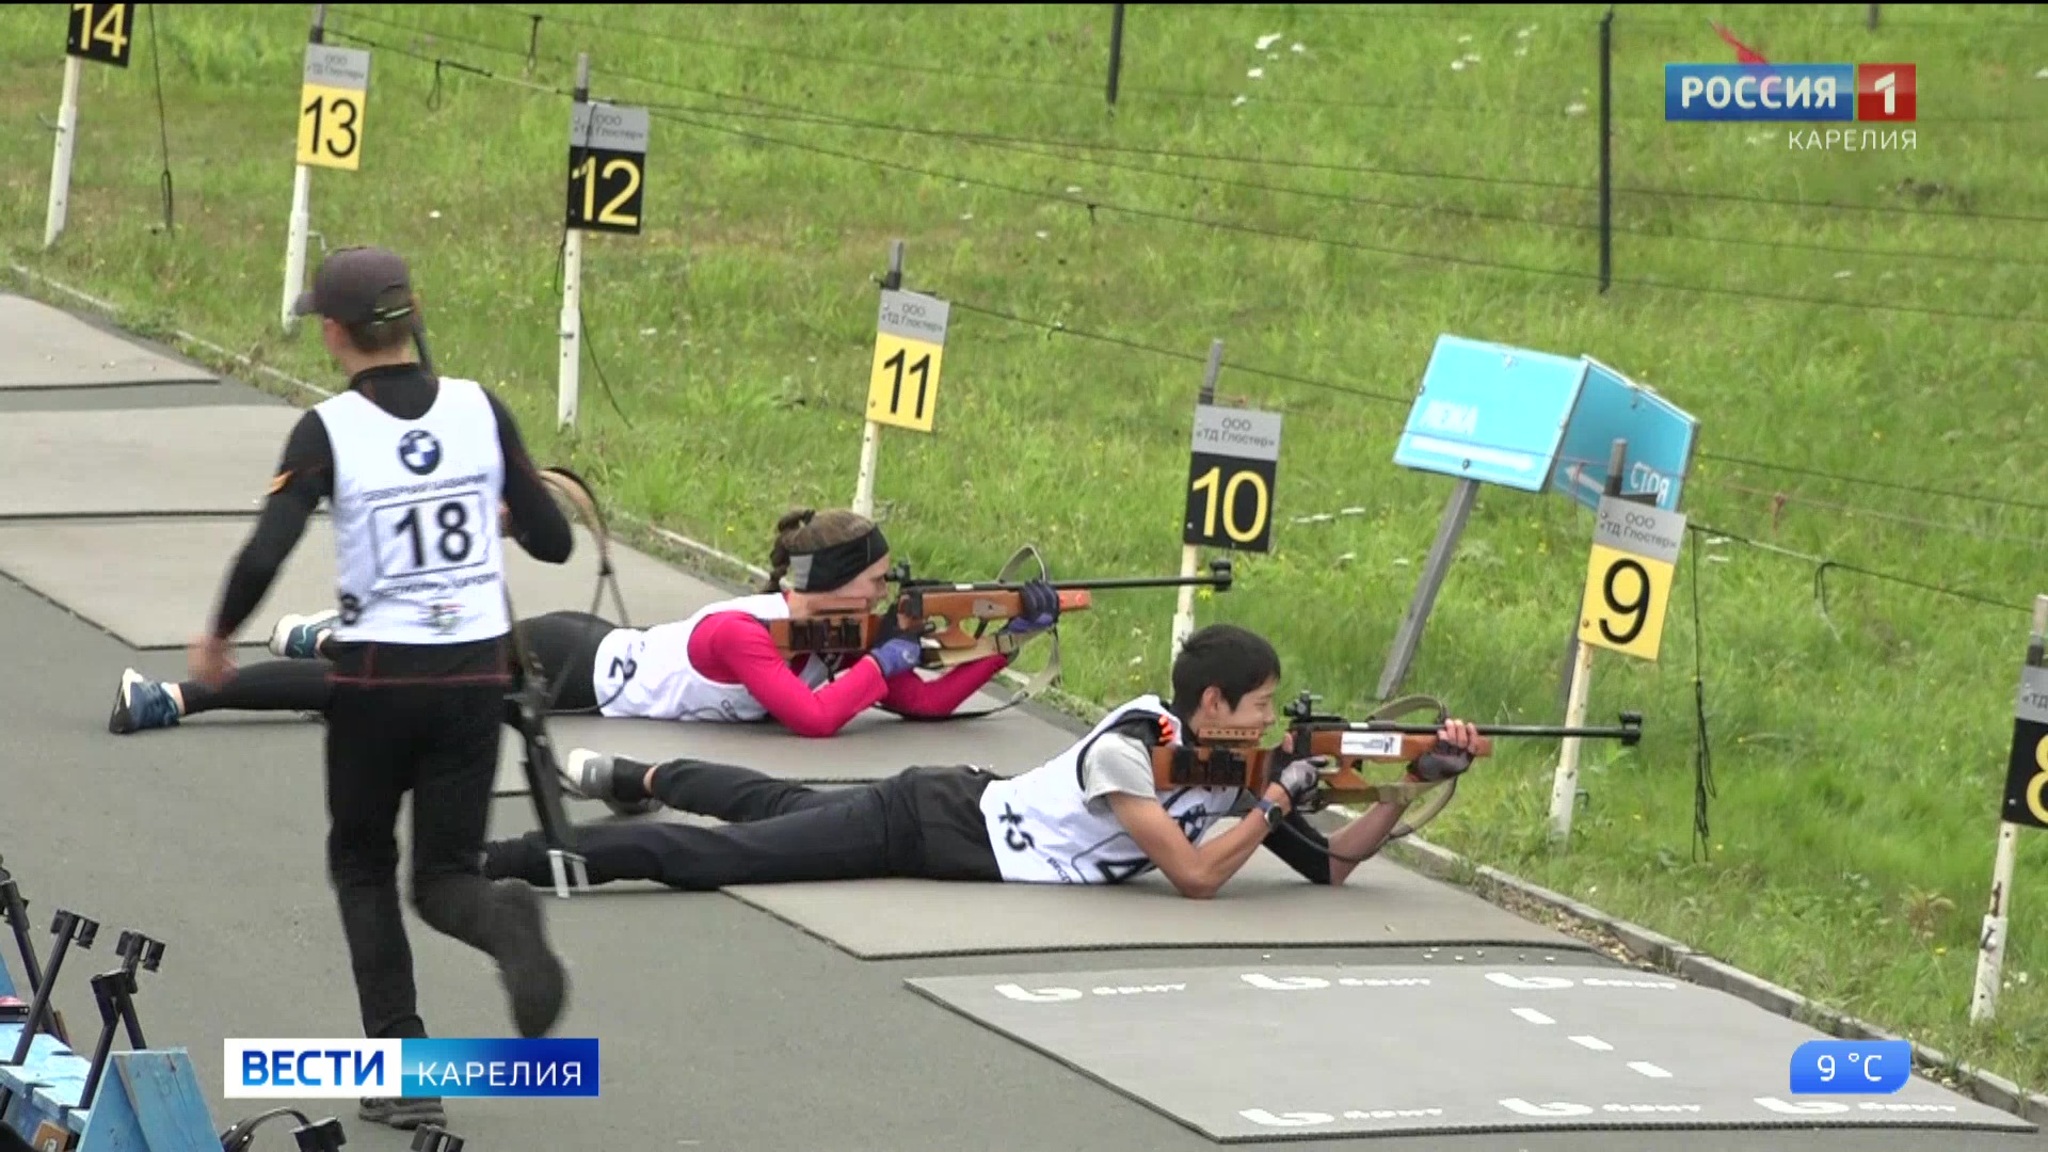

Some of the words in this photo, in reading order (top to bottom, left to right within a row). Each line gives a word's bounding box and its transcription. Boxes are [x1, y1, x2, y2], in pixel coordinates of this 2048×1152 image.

[73, 4, 127, 56] 14
[304, 97, 356, 157] 13
[573, 157, 640, 227] 12
[884, 349, 930, 418] 11
[1221, 417, 1251, 431] ООО
[393, 501, 473, 568] 18
[1193, 467, 1268, 543] 10
[1625, 512, 1656, 530] ООО
[1599, 559, 1650, 644] 9
